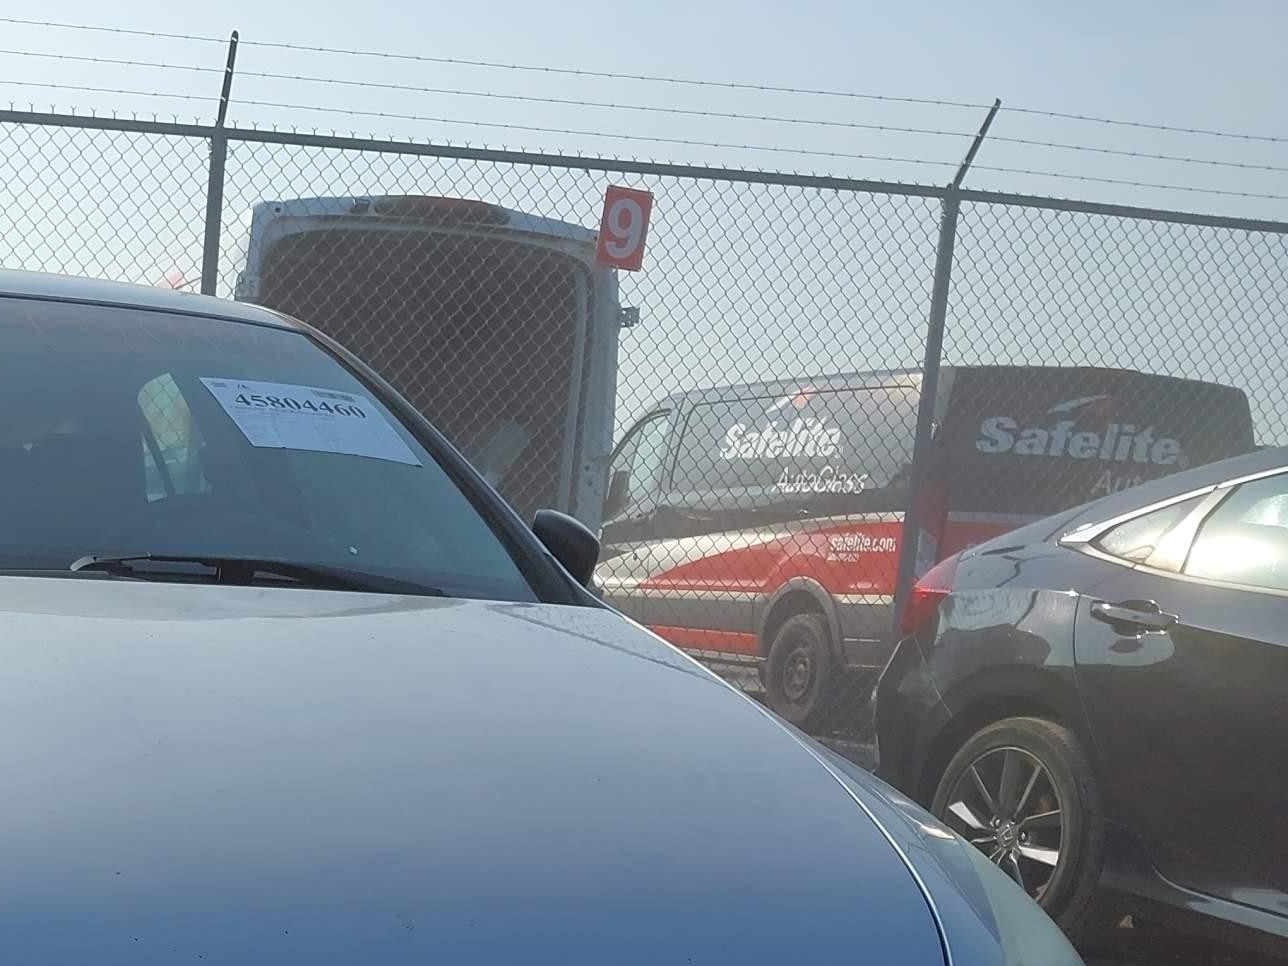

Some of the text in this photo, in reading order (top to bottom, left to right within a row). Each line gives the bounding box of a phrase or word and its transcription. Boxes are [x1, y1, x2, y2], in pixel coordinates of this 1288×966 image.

[605, 198, 643, 259] 9
[234, 393, 367, 419] 45804460
[720, 415, 841, 460] Safelite
[975, 416, 1181, 465] Safelite
[772, 466, 869, 494] AutoGlass
[830, 532, 897, 553] safelite.com
